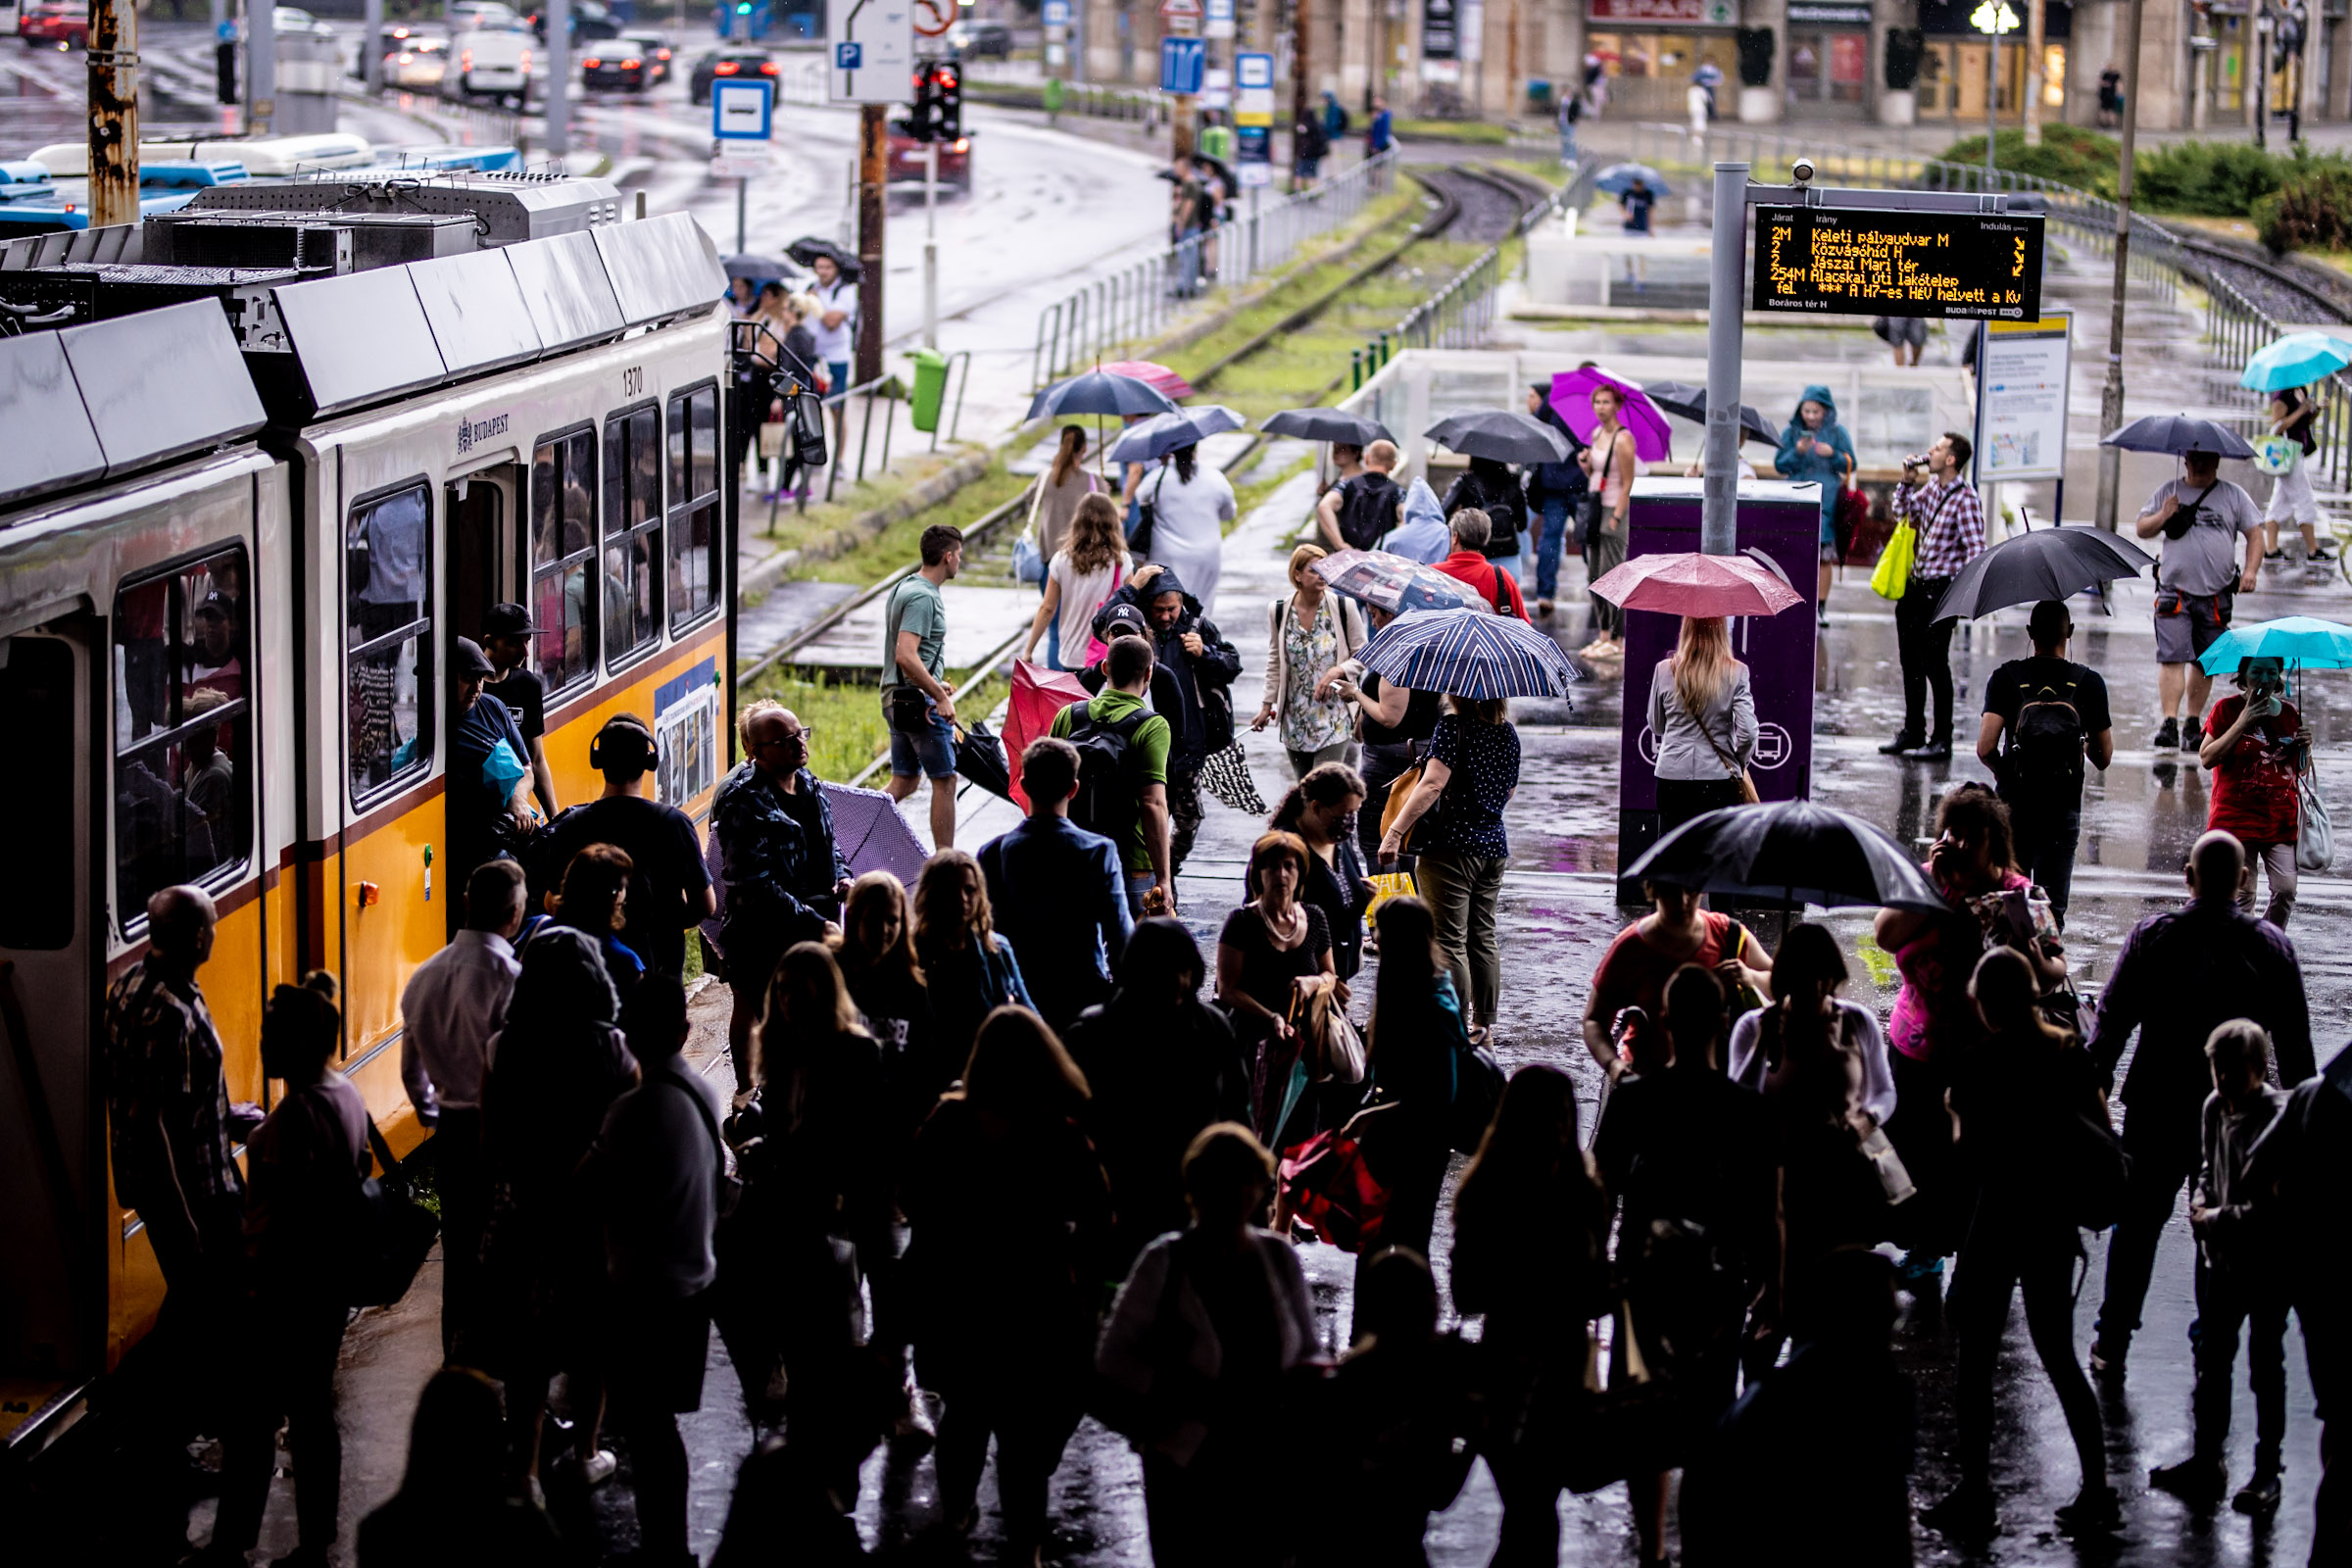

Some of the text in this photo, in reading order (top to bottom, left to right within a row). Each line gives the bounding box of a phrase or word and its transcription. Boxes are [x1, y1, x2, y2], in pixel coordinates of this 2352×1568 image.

[1772, 213, 1794, 222] Járat
[1816, 214, 1838, 225] Irány
[1981, 221, 2012, 231] Indulás
[1771, 226, 1949, 247] 2M Keleti pályaudvar M
[1771, 240, 1903, 259] 2 Közvágóhíd H
[1770, 254, 1920, 273] 2 Jászai Mari tér
[1770, 267, 1959, 288] 254M Alacskai úti lakótelep
[1768, 298, 1828, 309] Boráros tér H
[1848, 283, 1859, 298] A
[1863, 283, 1904, 300] H7-es
[1937, 286, 1986, 303] helyett
[1991, 292, 2001, 304] a
[623, 366, 643, 398] 1370
[473, 414, 510, 442] BUDAPEST
